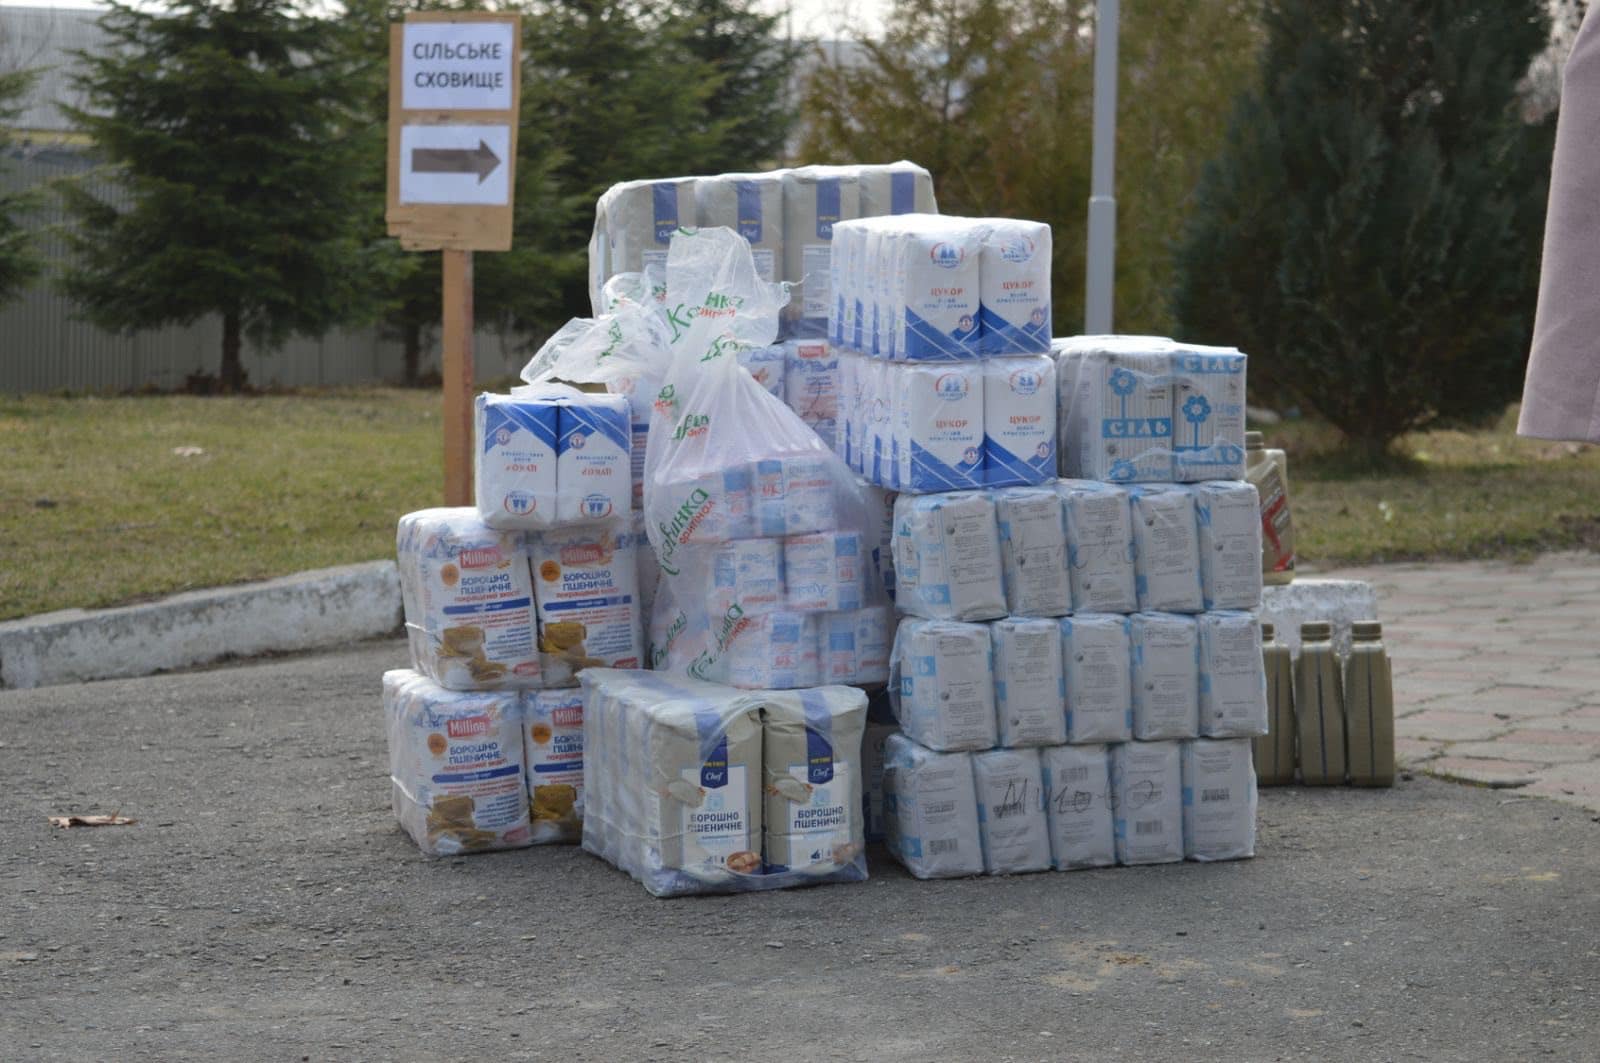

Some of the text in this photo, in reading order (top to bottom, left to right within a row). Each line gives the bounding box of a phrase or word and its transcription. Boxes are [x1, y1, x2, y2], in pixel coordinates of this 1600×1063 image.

[413, 42, 502, 60] СІЛЬСЬКЕ
[415, 72, 503, 90] СХОВИЩЕ
[1002, 280, 1034, 290] ЦУКОР
[930, 287, 963, 297] ЦУКОР
[936, 419, 968, 429] ЦУКОР
[1009, 416, 1041, 425] ЦУКОР
[1109, 420, 1168, 436] СІЛЬ
[461, 573, 509, 586] БОРОШНО
[563, 570, 611, 582] БОРОШНО
[461, 582, 512, 595] ПШЕНИЧНЕ
[563, 579, 613, 591] ПШЕНИЧНЕ
[450, 742, 498, 755] БОРОШНО
[449, 751, 500, 764] ПШЕНИЧНЕ
[705, 771, 723, 782] Chef
[690, 811, 740, 823] БОРОШНО
[798, 806, 844, 819] БОРОШНО
